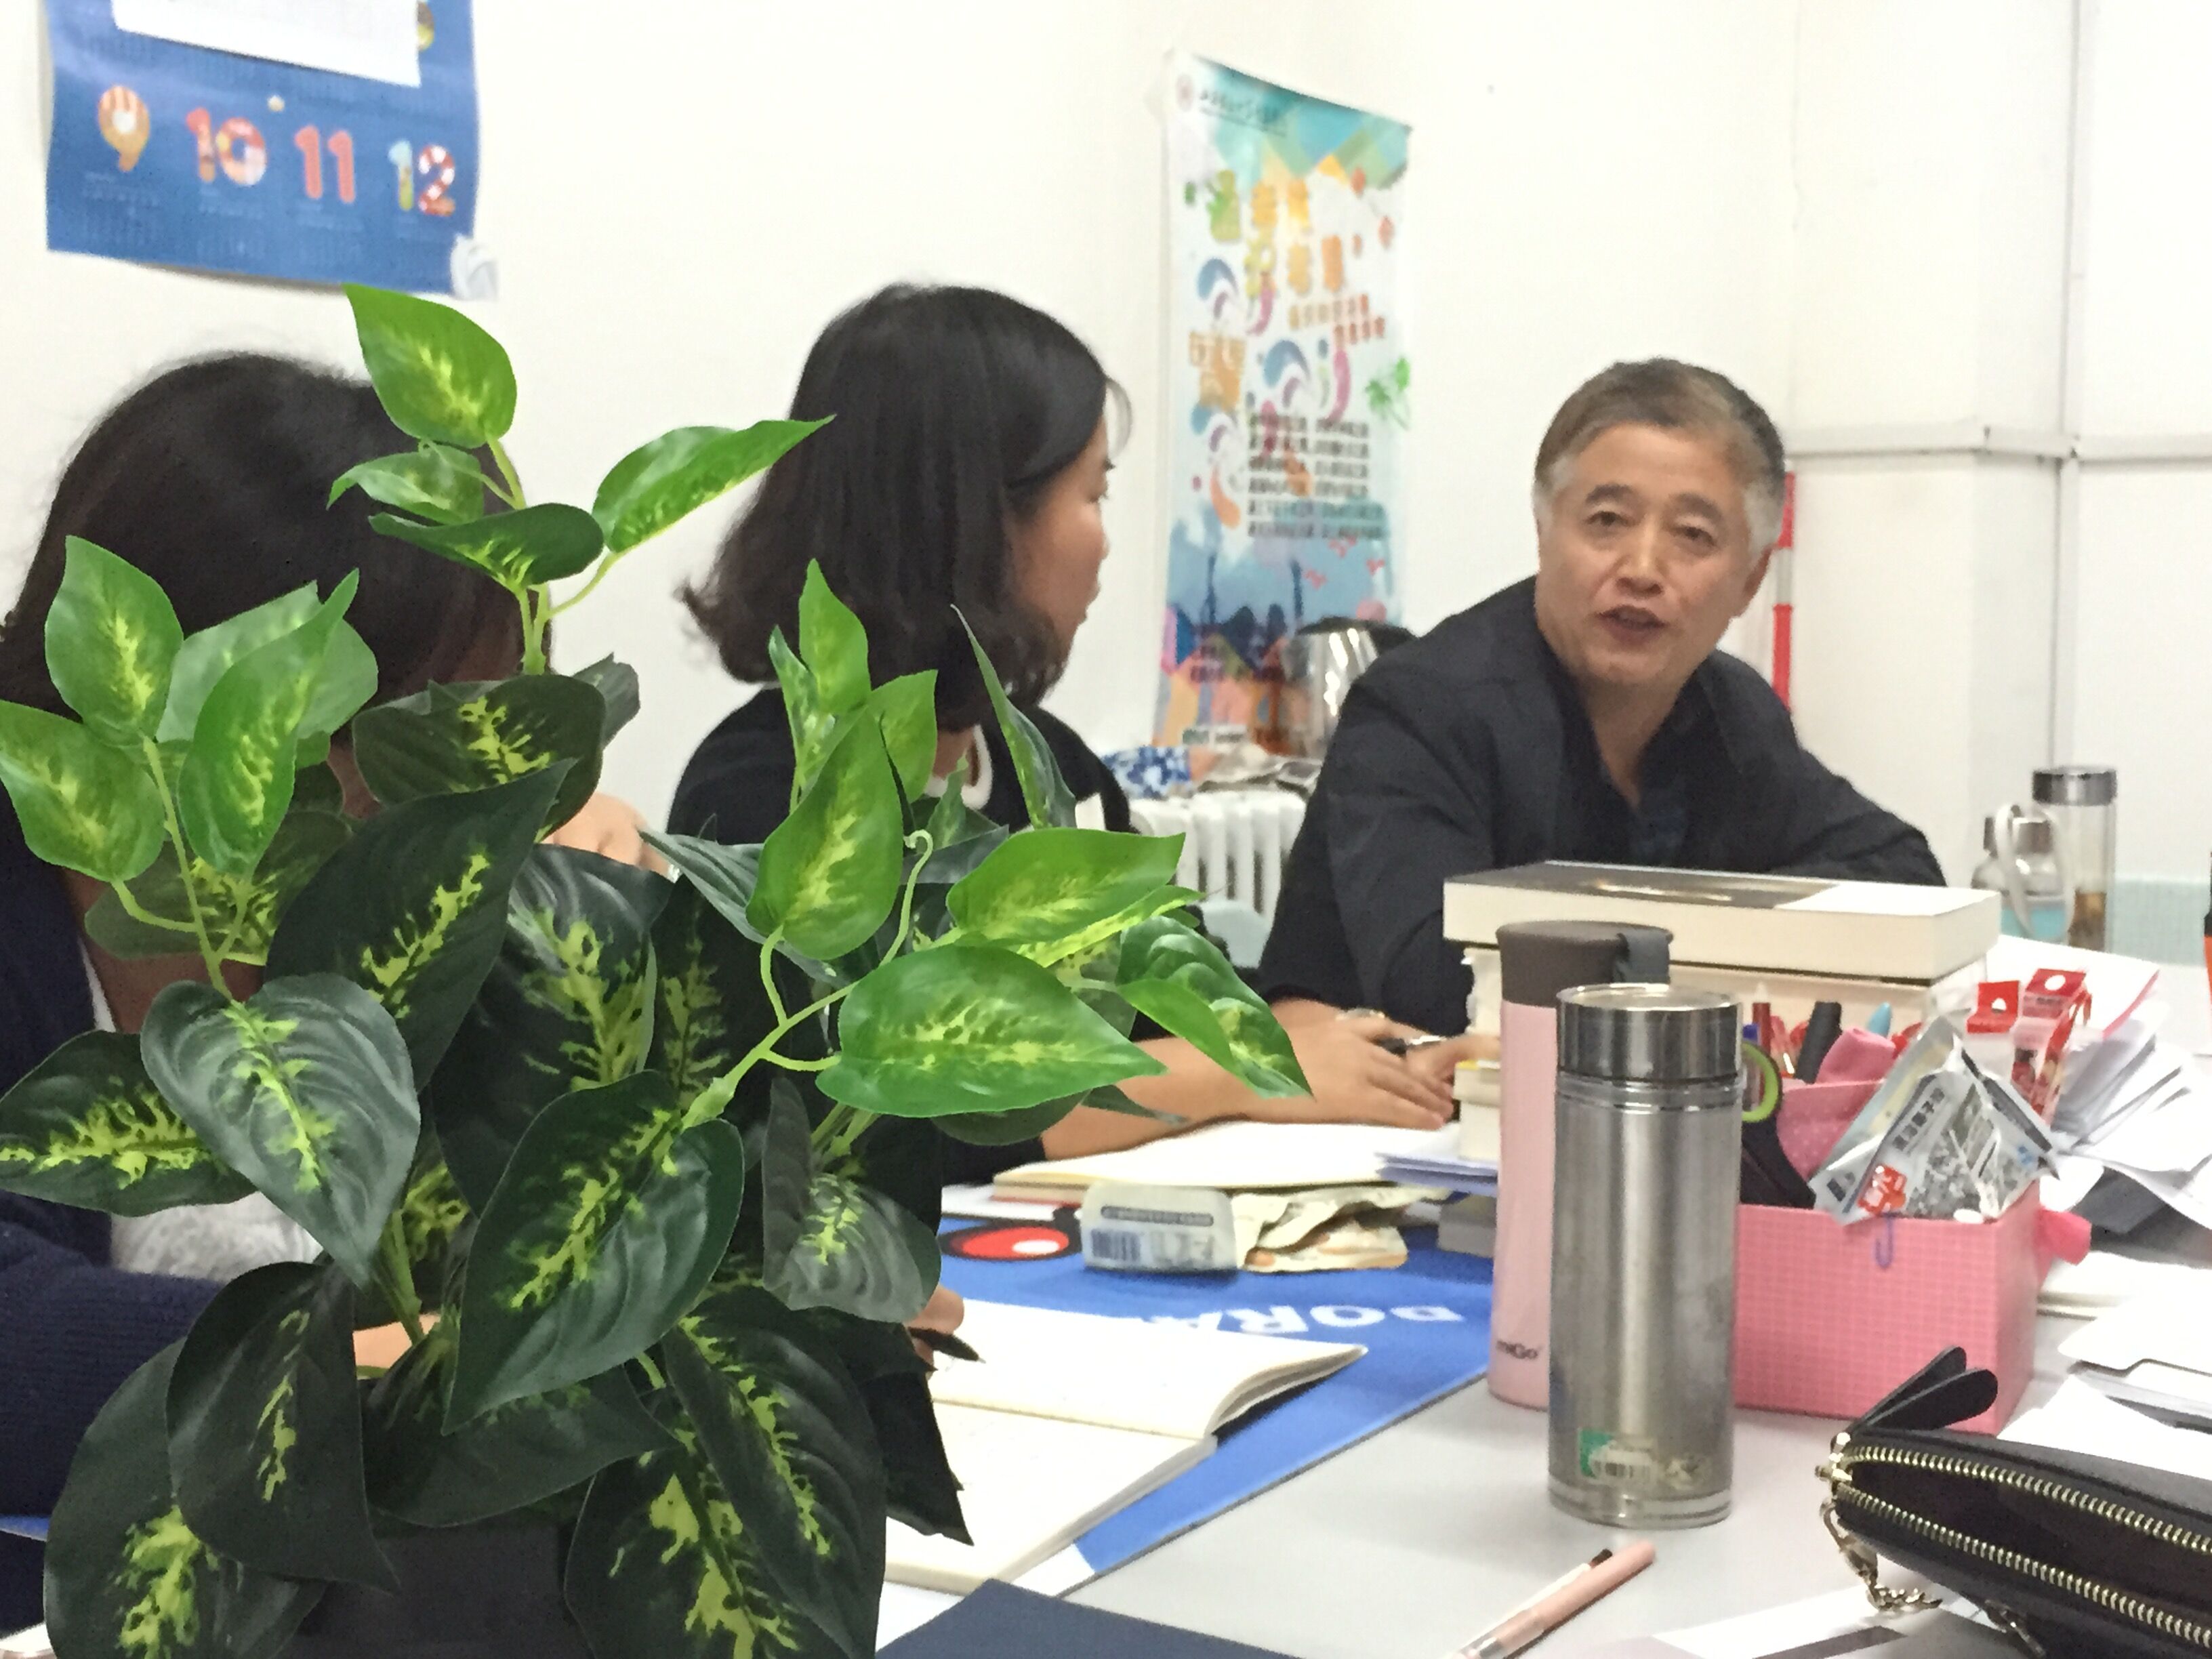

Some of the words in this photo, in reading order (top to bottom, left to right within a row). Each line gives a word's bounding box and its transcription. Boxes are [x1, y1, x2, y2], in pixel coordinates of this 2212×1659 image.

[98, 85, 150, 172] 9
[186, 106, 268, 186] 10
[294, 125, 355, 203] 11
[388, 140, 456, 217] 12
